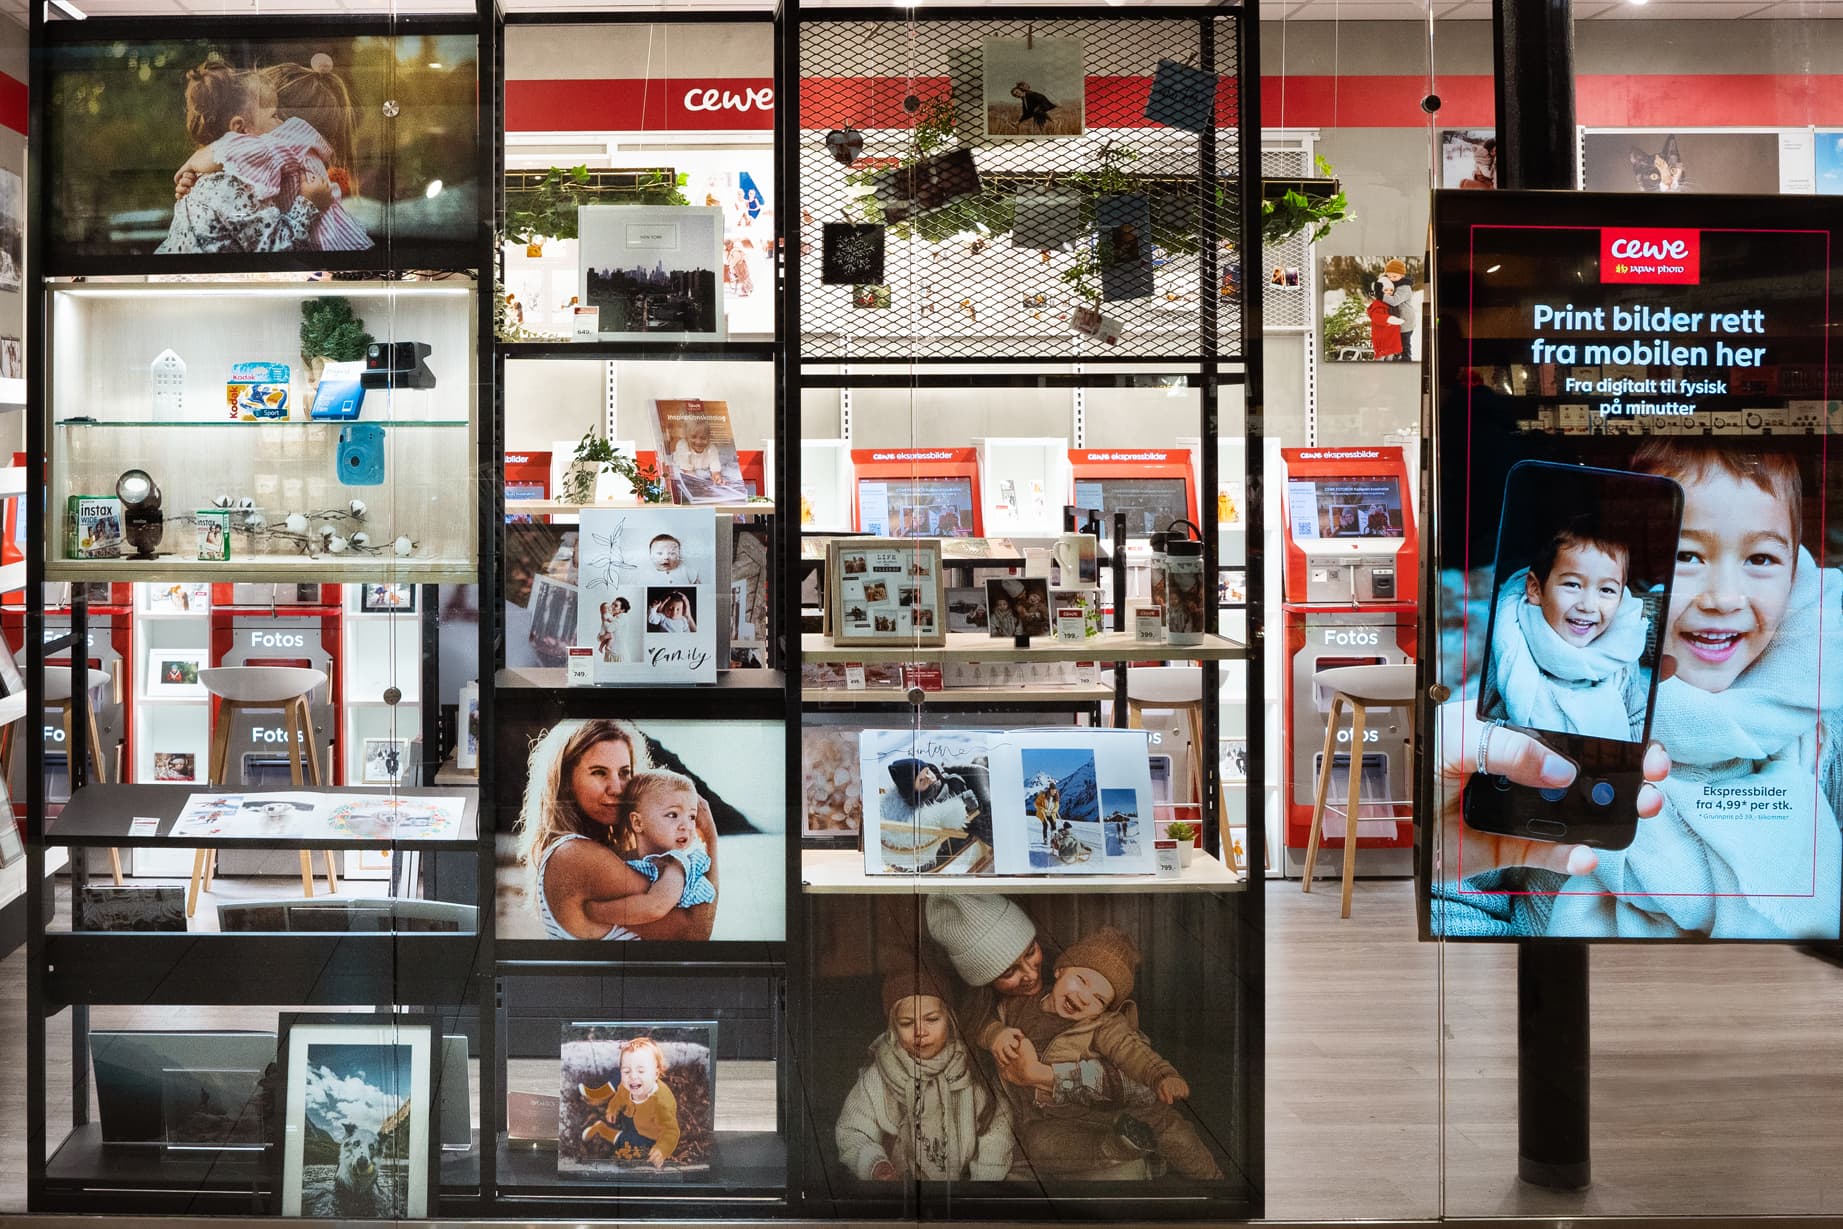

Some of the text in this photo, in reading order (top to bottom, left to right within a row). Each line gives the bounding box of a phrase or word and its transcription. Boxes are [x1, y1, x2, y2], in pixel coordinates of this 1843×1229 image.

[684, 87, 775, 112] cewe
[1611, 238, 1689, 260] cewe
[1533, 303, 1765, 333] Print bilder rett
[1531, 338, 1767, 366] fra mobilen her
[1565, 377, 1727, 397] Fra digitalt til fysisk
[230, 386, 240, 418] Kodak
[1600, 398, 1696, 418] på minutter
[263, 408, 280, 417] Sport
[897, 451, 953, 460] ekspressbilder
[1111, 452, 1167, 461] ekspressbilder
[1324, 451, 1380, 460] ekspressbilder
[81, 503, 112, 516] instax
[251, 631, 304, 647] Fotos
[1325, 630, 1379, 645] Fotos
[651, 647, 711, 670] family
[1703, 786, 1787, 798] Ekspressbilder
[1696, 799, 1712, 809] fra
[1750, 802, 1770, 812] per
[1772, 800, 1793, 810] stk.
